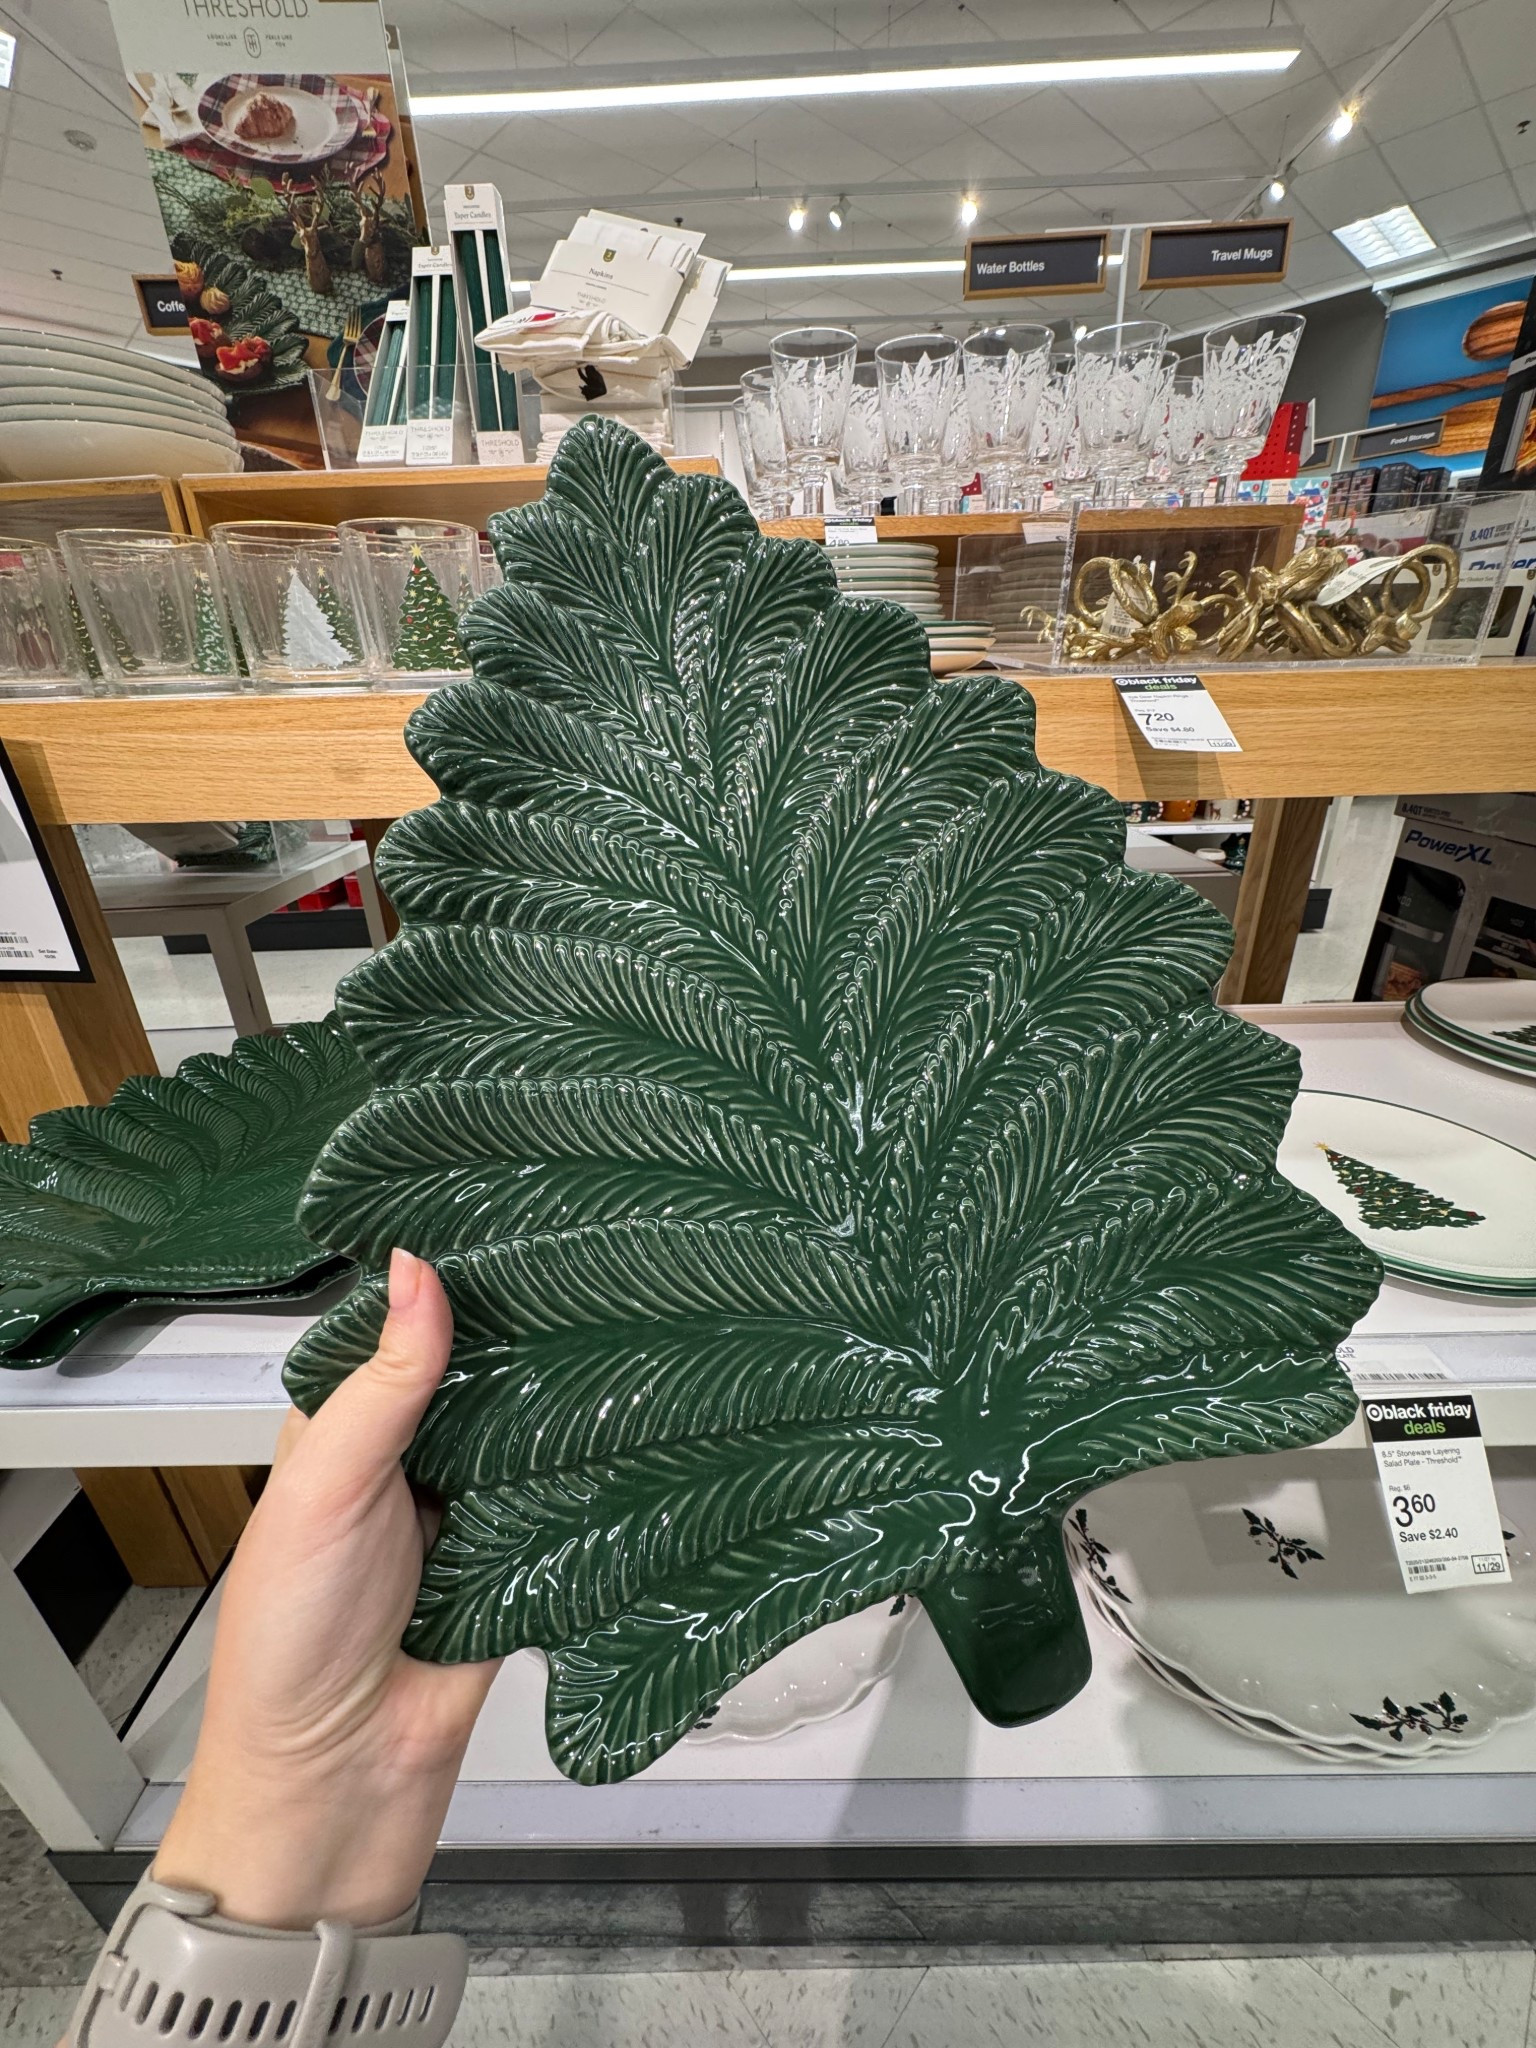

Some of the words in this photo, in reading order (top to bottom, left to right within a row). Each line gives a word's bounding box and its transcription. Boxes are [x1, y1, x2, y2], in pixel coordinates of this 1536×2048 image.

[183, 0, 310, 18] THRESHOLD
[1211, 249, 1241, 261] Travel
[1243, 247, 1273, 261] Mugs
[588, 267, 613, 280] Napkins
[976, 262, 1007, 274] Water
[1009, 260, 1045, 272] Bottles
[157, 300, 187, 312] Coffe
[1390, 437, 1408, 445] Food
[1408, 431, 1436, 442] Storage
[1470, 526, 1496, 542] 8.4QT
[1163, 676, 1197, 684] friday
[1404, 829, 1493, 866] PowerXL
[1383, 1404, 1426, 1420] black
[1428, 1401, 1472, 1419] friday
[1404, 1419, 1446, 1435] deals
[1396, 1449, 1432, 1458] Stoneware
[1432, 1448, 1460, 1456] Layering
[1383, 1459, 1403, 1467] Salad
[1403, 1458, 1421, 1466] Plate
[1388, 1484, 1403, 1492] Reg.
[1399, 1529, 1427, 1543] Save
[1428, 1527, 1459, 1541] $2.40
[1476, 1561, 1501, 1572] 11/29
